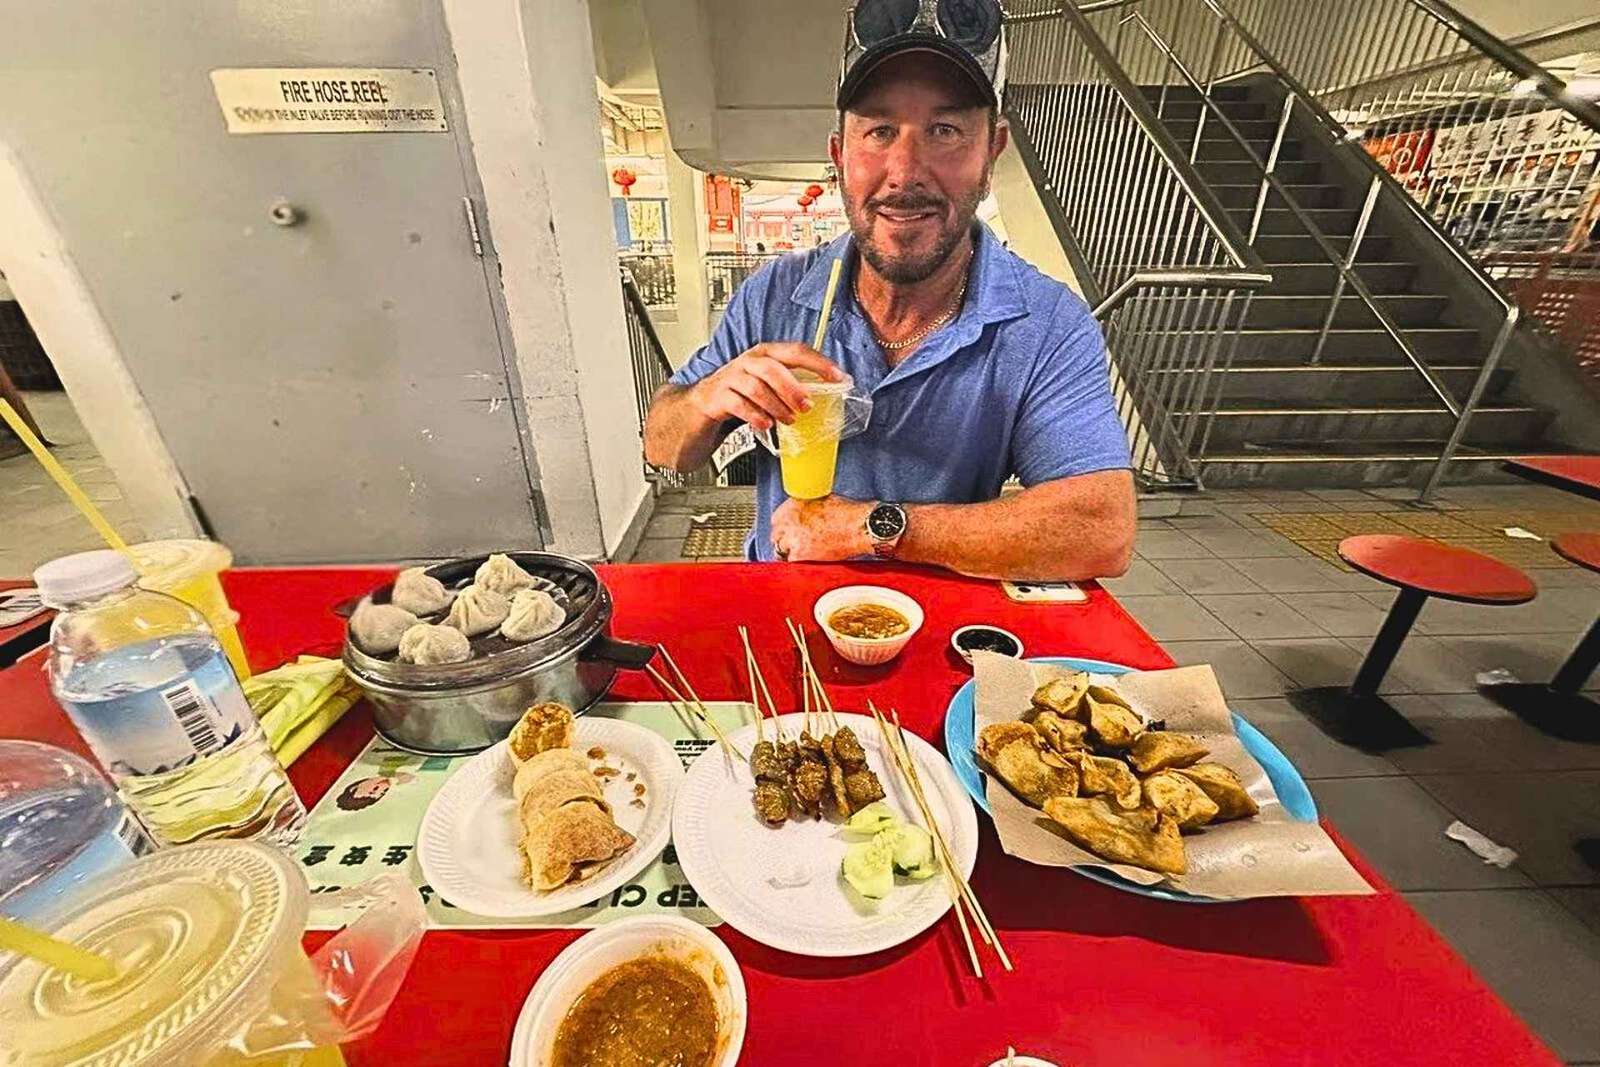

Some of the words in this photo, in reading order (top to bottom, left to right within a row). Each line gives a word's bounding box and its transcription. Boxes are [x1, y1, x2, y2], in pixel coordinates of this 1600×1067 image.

[280, 80, 313, 103] FIRE
[312, 80, 351, 103] HOSE
[351, 80, 389, 103] REEL
[290, 109, 309, 121] INLET
[309, 109, 331, 121] VALVE
[331, 109, 358, 121] BEFORE
[358, 109, 388, 121] RUNNING
[416, 109, 435, 121] HOSE
